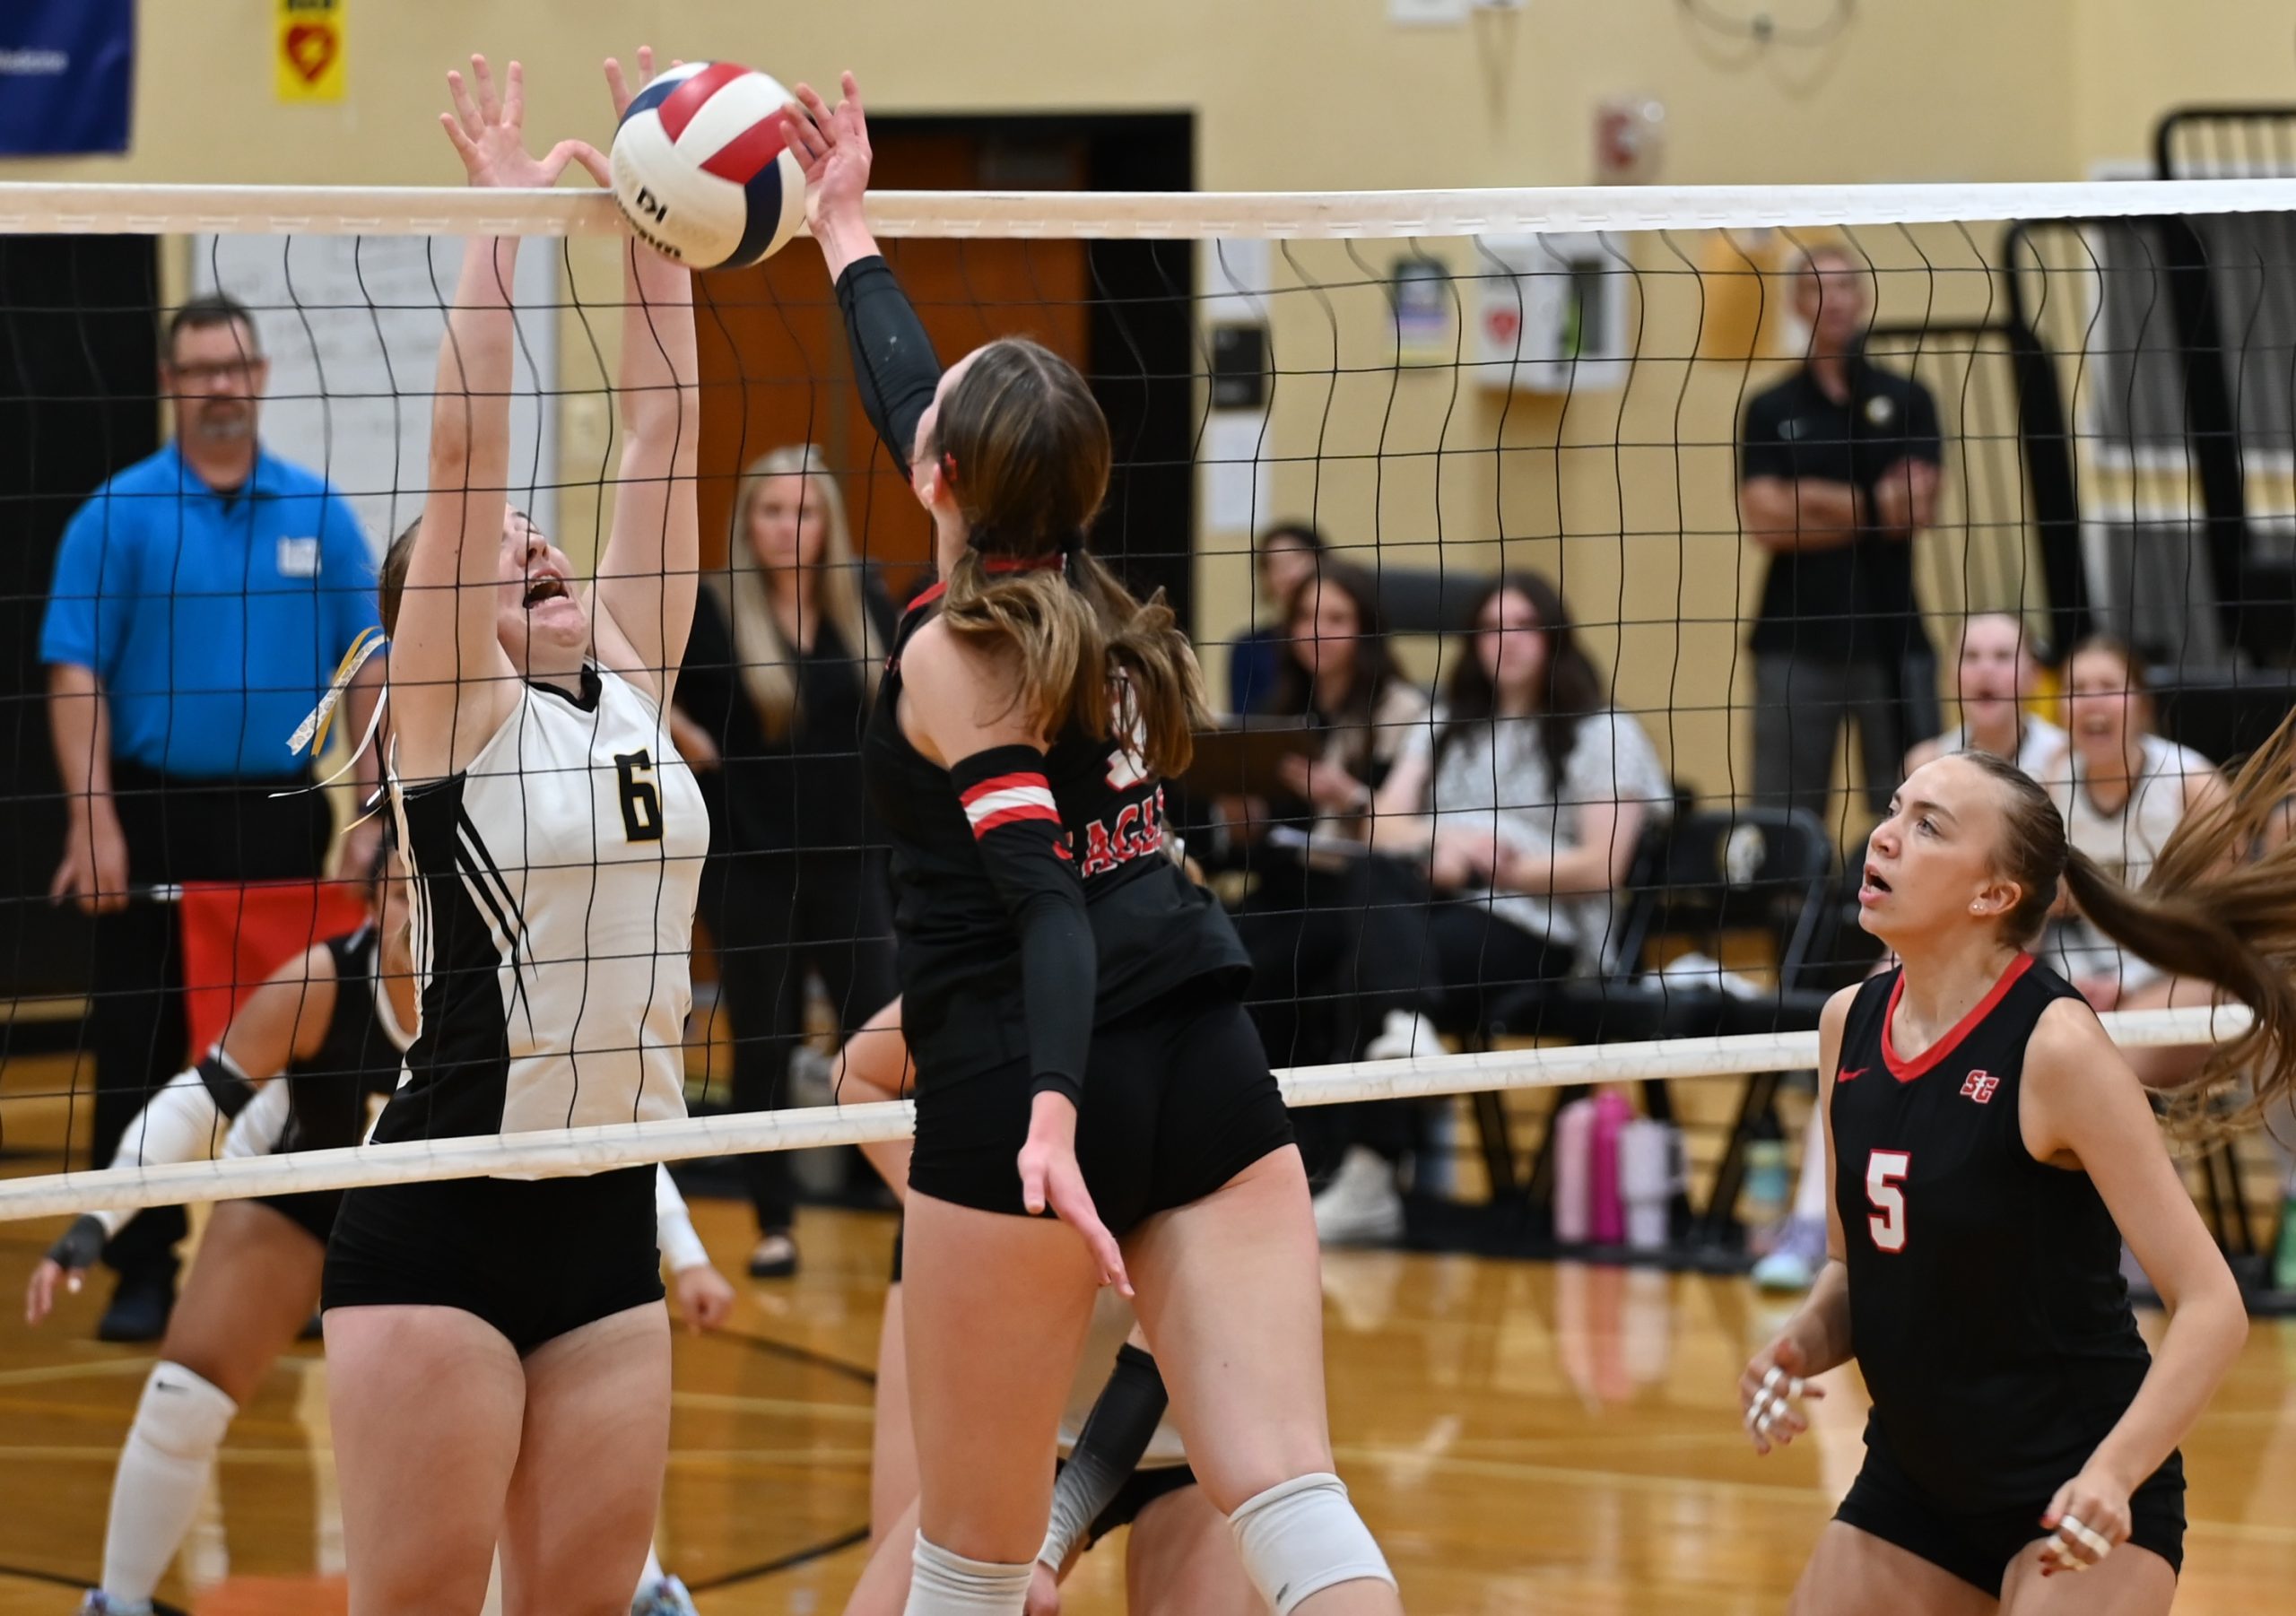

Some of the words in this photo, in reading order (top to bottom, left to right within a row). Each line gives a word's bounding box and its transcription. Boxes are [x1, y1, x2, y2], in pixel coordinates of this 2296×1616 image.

[613, 747, 665, 844] 6
[1960, 1069, 1999, 1104] SG
[1866, 1148, 1911, 1254] 5
